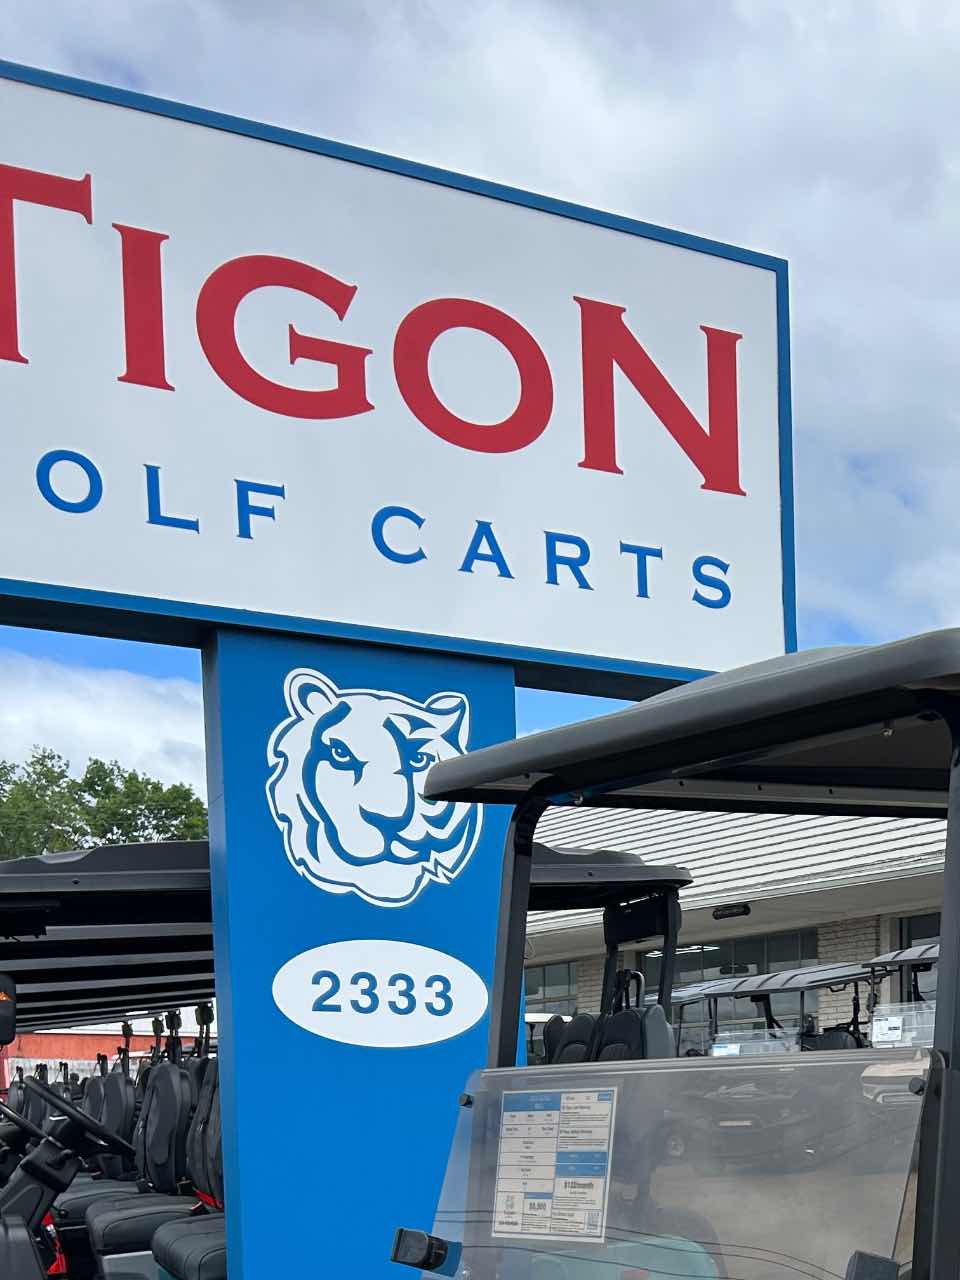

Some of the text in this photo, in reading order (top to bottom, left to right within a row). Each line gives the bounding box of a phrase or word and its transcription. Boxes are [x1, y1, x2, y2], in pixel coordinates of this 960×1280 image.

[35, 449, 732, 609] OLF CARTS
[311, 970, 454, 1017] 2333
